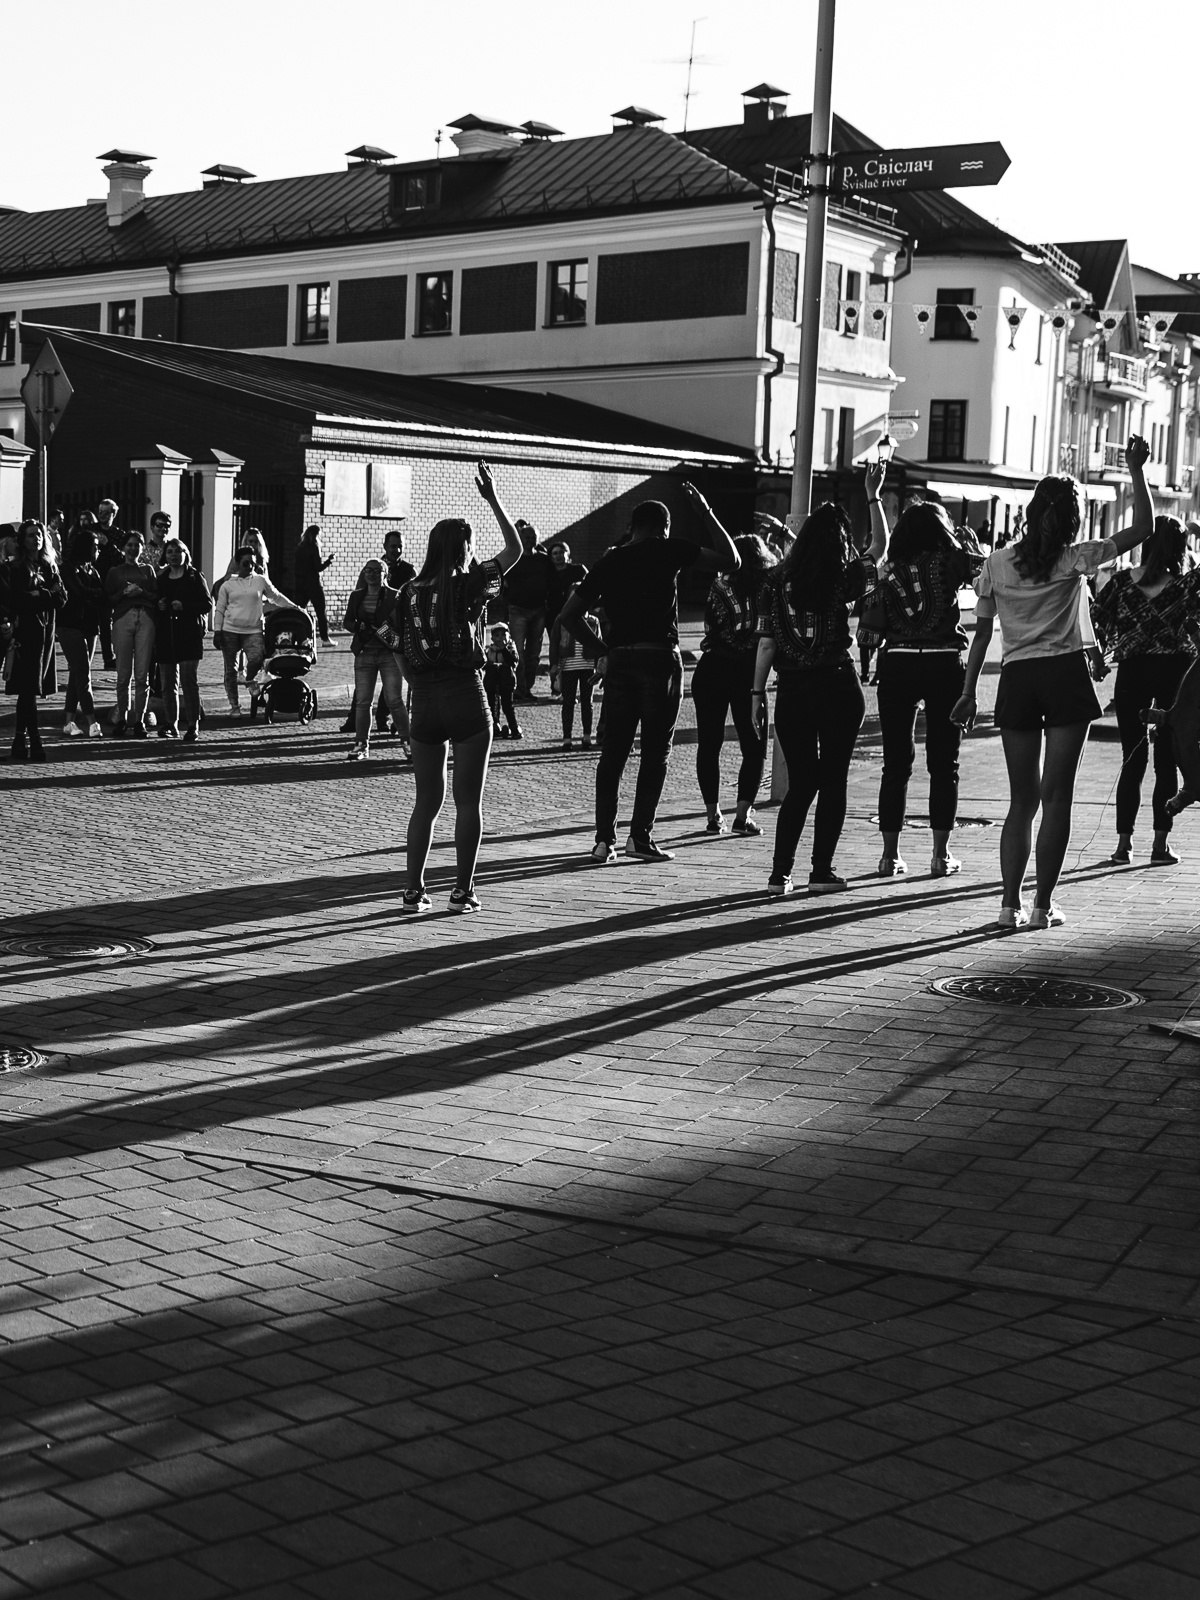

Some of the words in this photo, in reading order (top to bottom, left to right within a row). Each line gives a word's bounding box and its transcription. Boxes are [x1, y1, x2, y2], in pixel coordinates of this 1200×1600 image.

[843, 166, 858, 182] р.
[864, 158, 933, 176] Свіслач
[842, 179, 879, 190] Svislač
[882, 177, 907, 188] river
